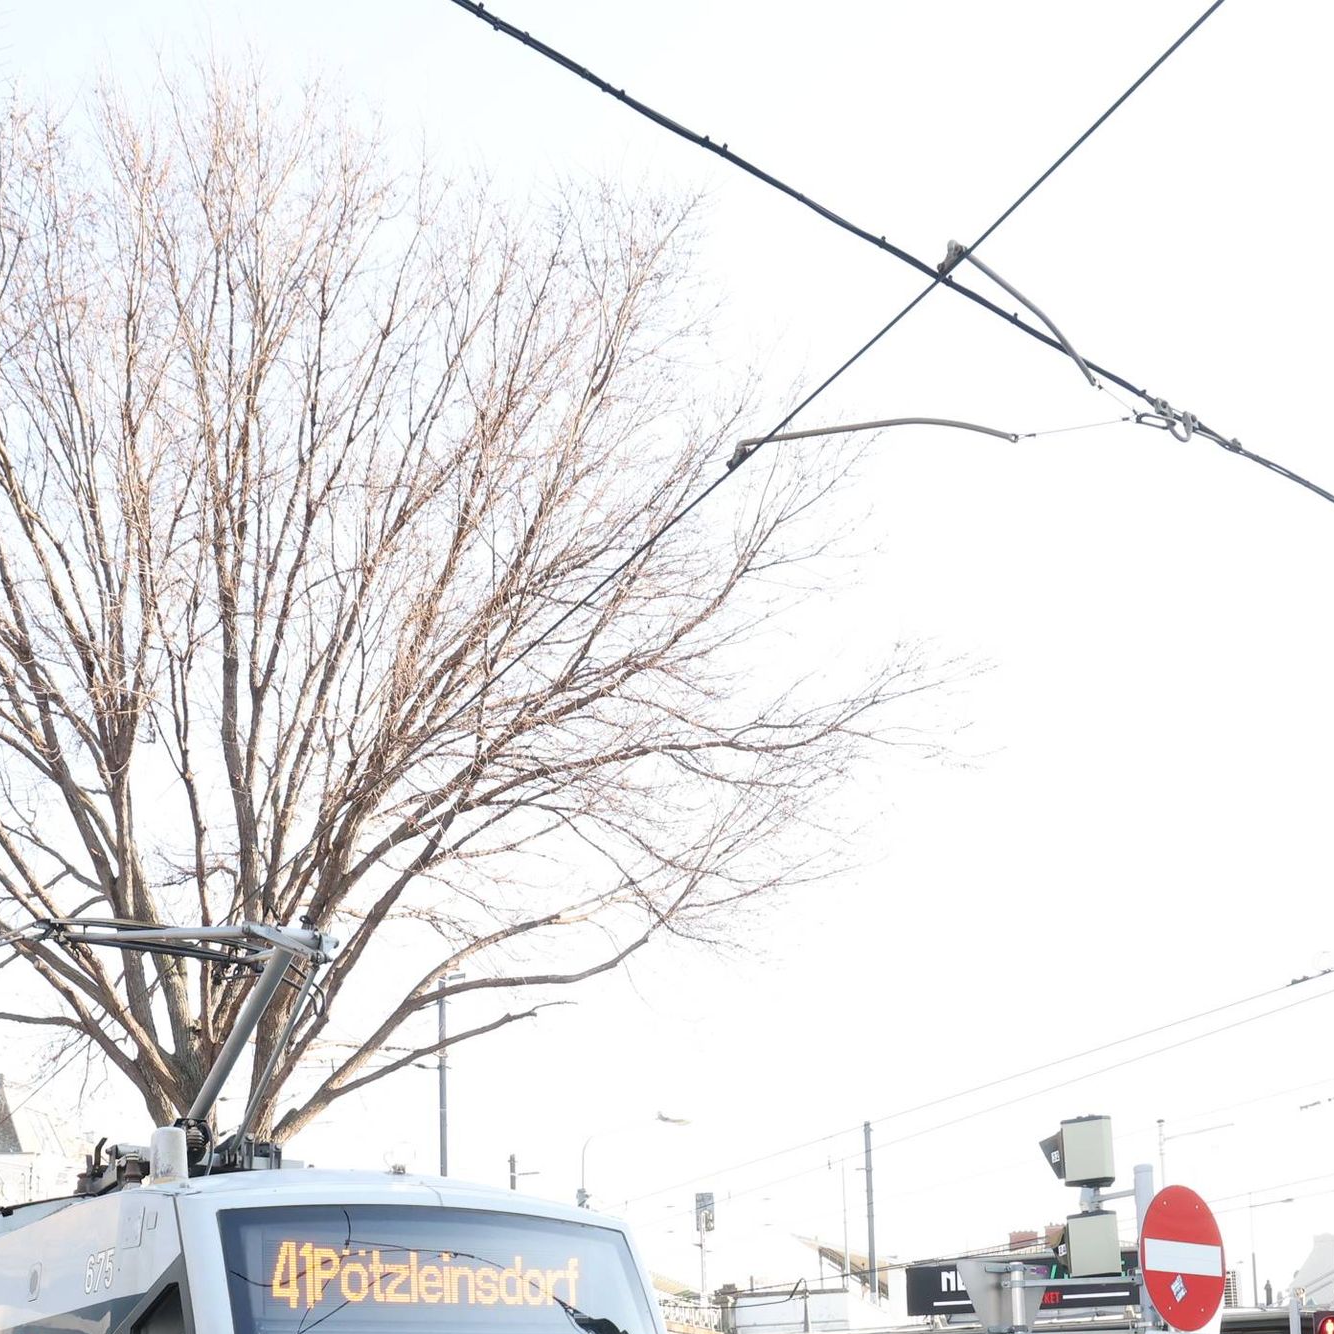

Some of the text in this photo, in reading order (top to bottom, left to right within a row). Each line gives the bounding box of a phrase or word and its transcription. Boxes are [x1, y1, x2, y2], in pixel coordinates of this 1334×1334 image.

[84, 1246, 116, 1294] 675
[272, 1240, 579, 1309] 41 Pötzleinsdorf
